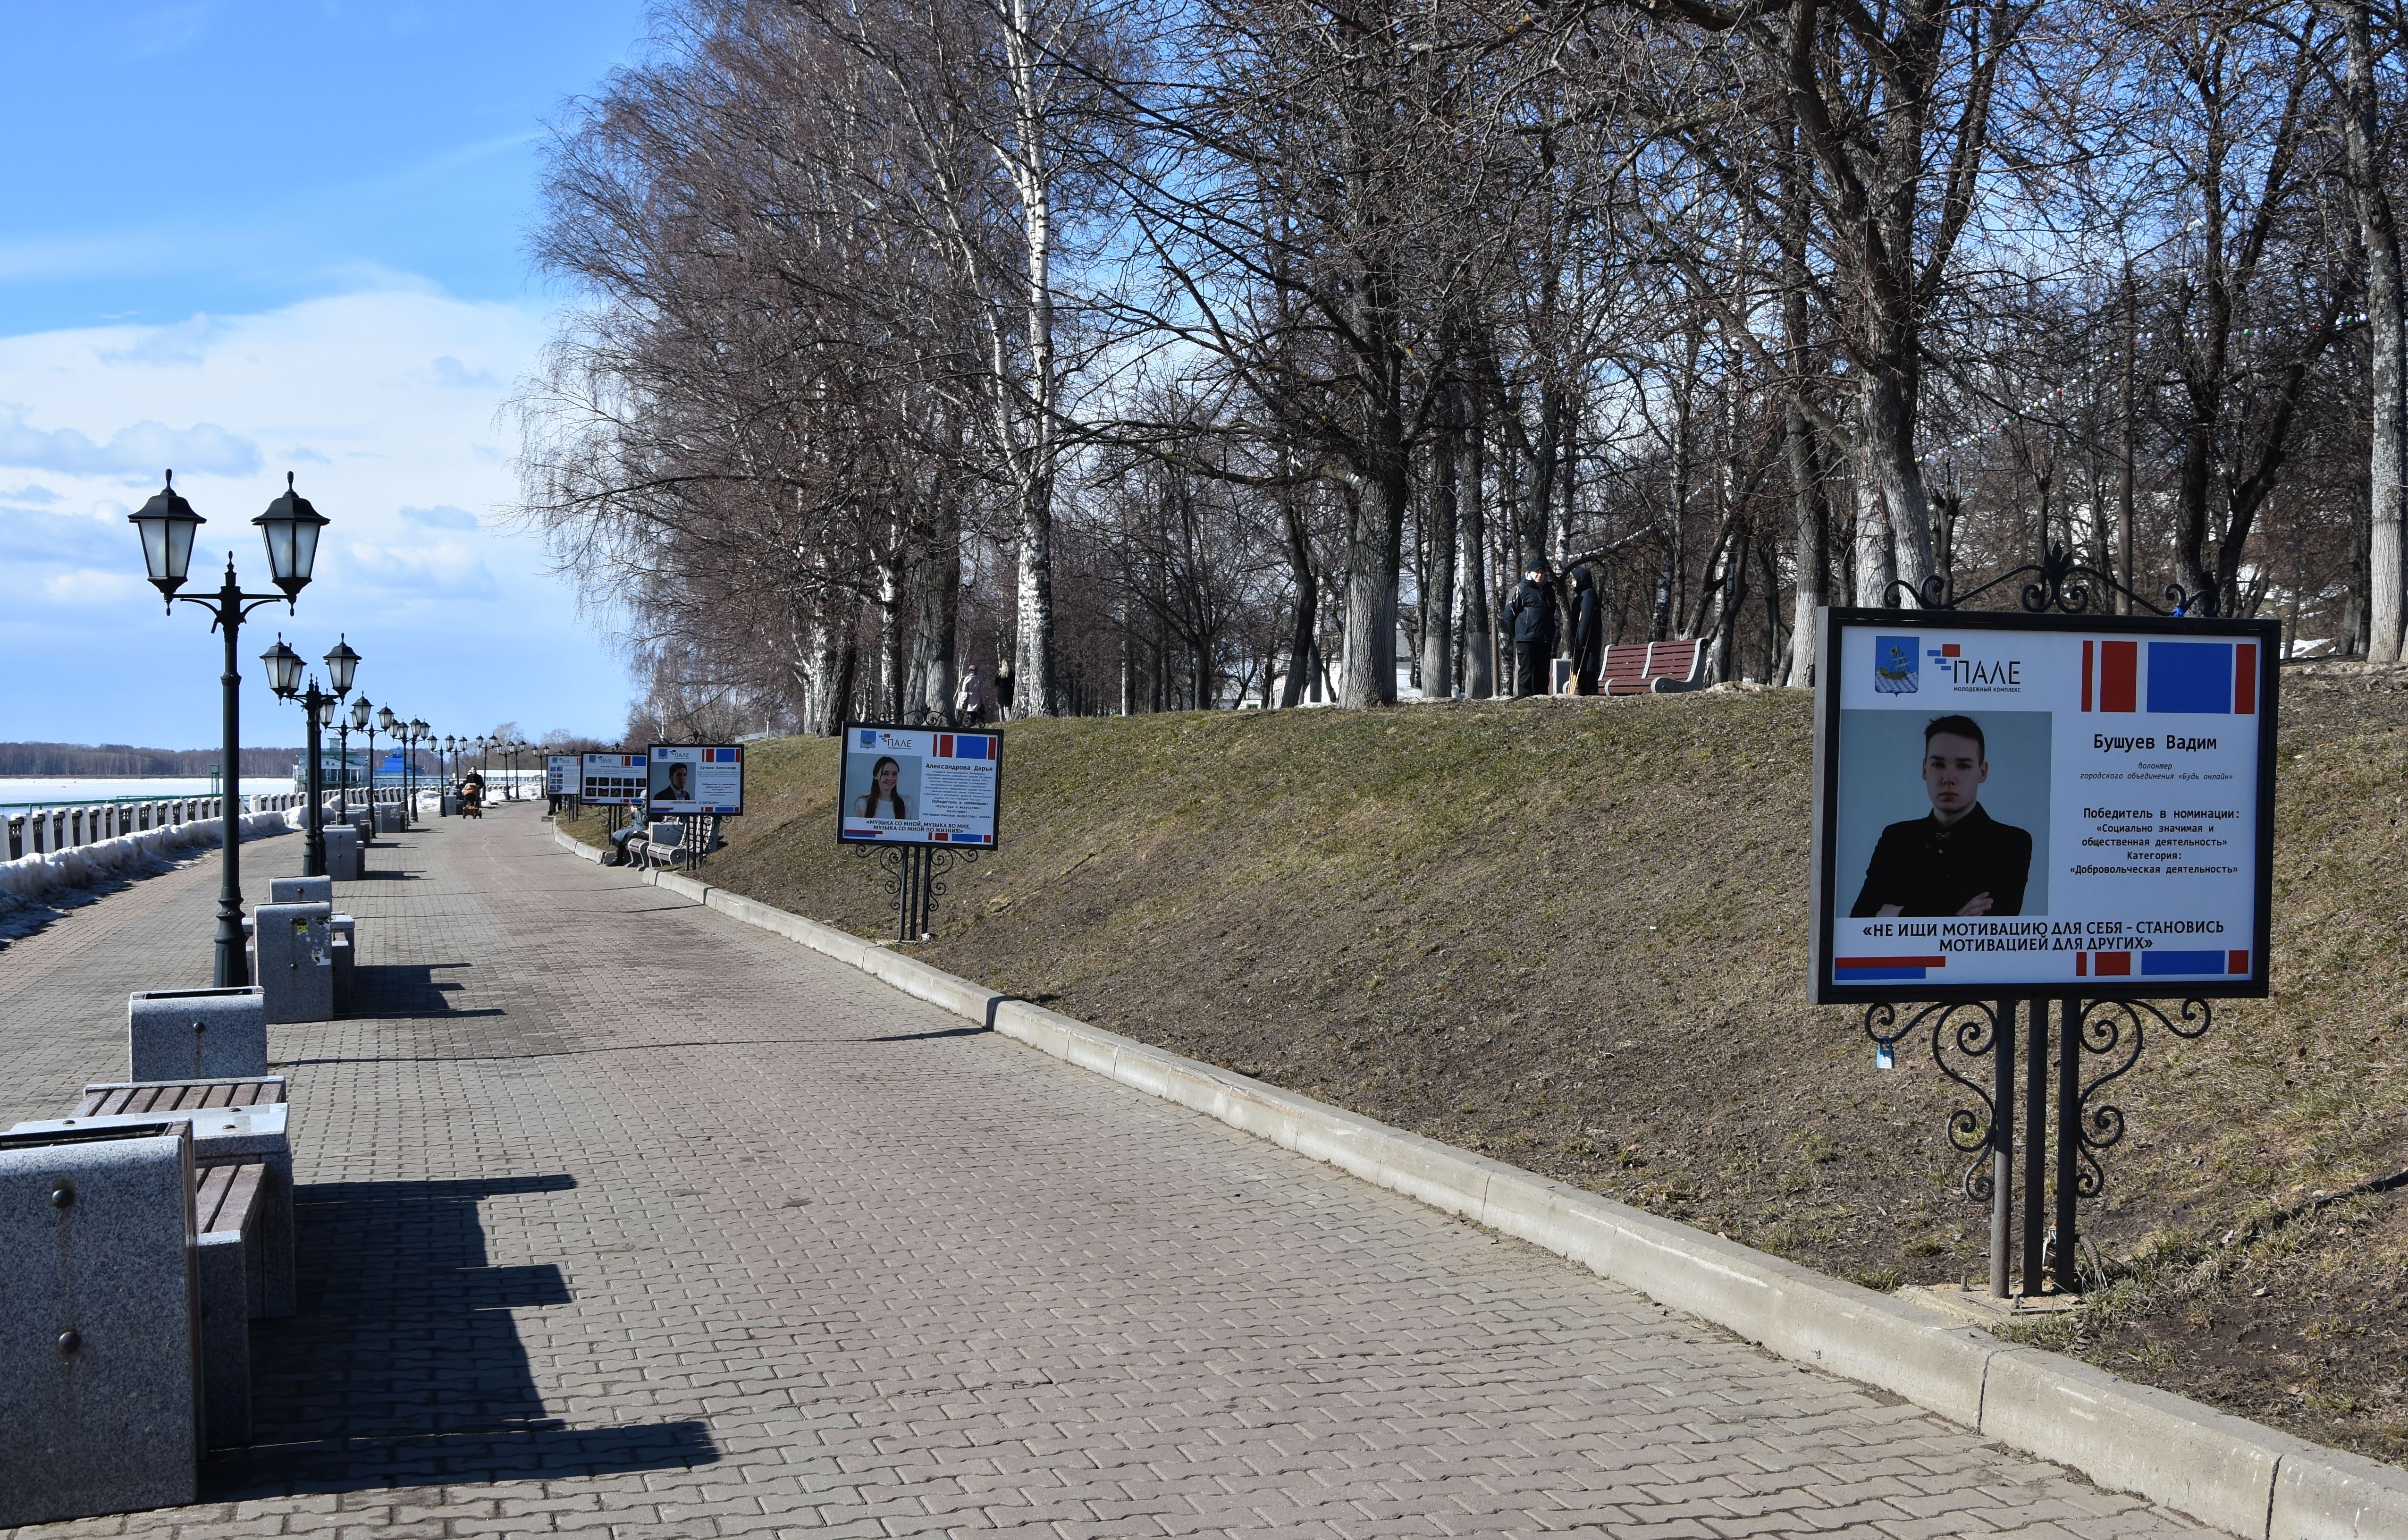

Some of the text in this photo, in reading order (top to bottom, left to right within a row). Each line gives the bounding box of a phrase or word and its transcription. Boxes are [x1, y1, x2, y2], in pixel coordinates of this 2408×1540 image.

[1954, 660, 2021, 685] ПАЛЕ
[887, 738, 912, 747] ПАЛЕ
[2094, 734, 2217, 753] Бушуев Вадим
[2138, 762, 2172, 771] волонтер
[2080, 772, 2123, 780] городского
[2178, 772, 2199, 781] «Будь
[2084, 807, 2239, 821] Победитель в номинации:
[2096, 823, 2153, 834] «Социально
[2082, 837, 2227, 847] общественная деятельность»
[2127, 851, 2181, 862] Категория:
[2070, 864, 2238, 876] «Добровольческая деятельность»
[1863, 924, 1893, 937] «НЕ
[1898, 923, 1937, 938] ИЩИ
[1942, 922, 2048, 938] МОТИВАЦИЮ
[2051, 922, 2081, 936] ДЛЯ
[2086, 922, 2122, 934] СЕБЯ
[2136, 921, 2224, 934] СТАНОВИСЬ
[1939, 935, 2153, 952] МОТИВАЦИЕЙ ДЛЯ ДРУГИХ»
